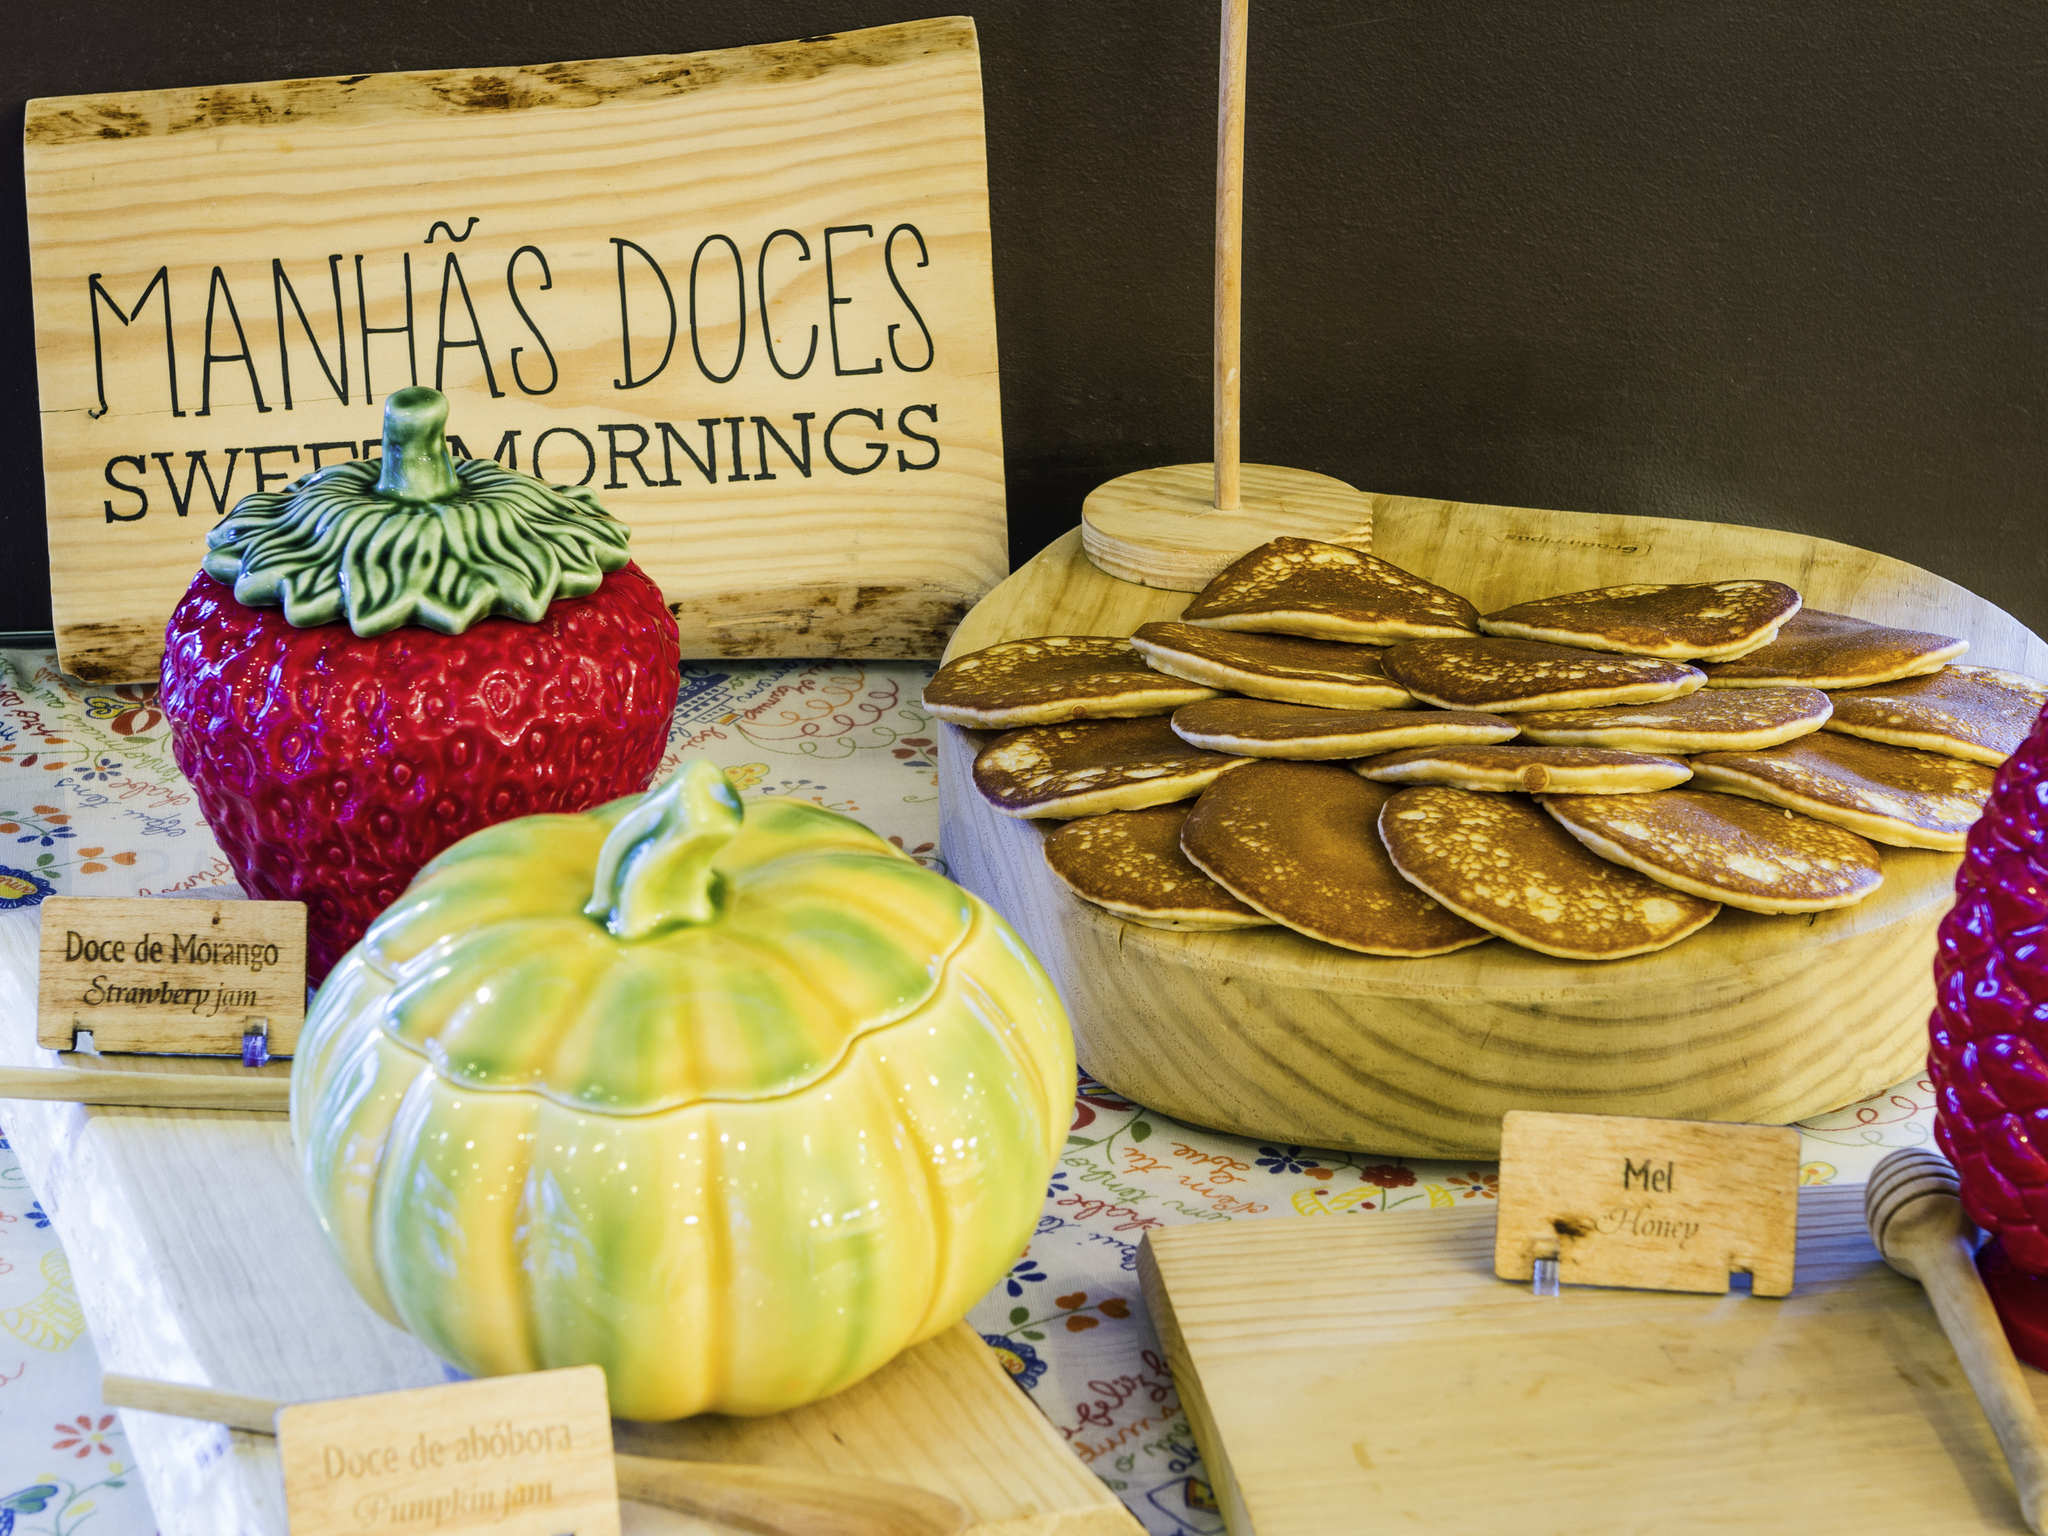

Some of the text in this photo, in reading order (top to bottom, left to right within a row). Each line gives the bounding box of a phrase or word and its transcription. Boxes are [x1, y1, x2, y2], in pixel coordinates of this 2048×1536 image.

[88, 216, 935, 419] MANHÃS DOCES
[105, 440, 384, 523] SWE
[65, 930, 279, 973] Doce de Morango
[206, 982, 258, 1018] jam
[1623, 1156, 1674, 1194] Mel
[1593, 1205, 1700, 1250] Honey
[323, 1420, 572, 1481] Doce de abóbora
[353, 1480, 554, 1528] Pumpkin jam
